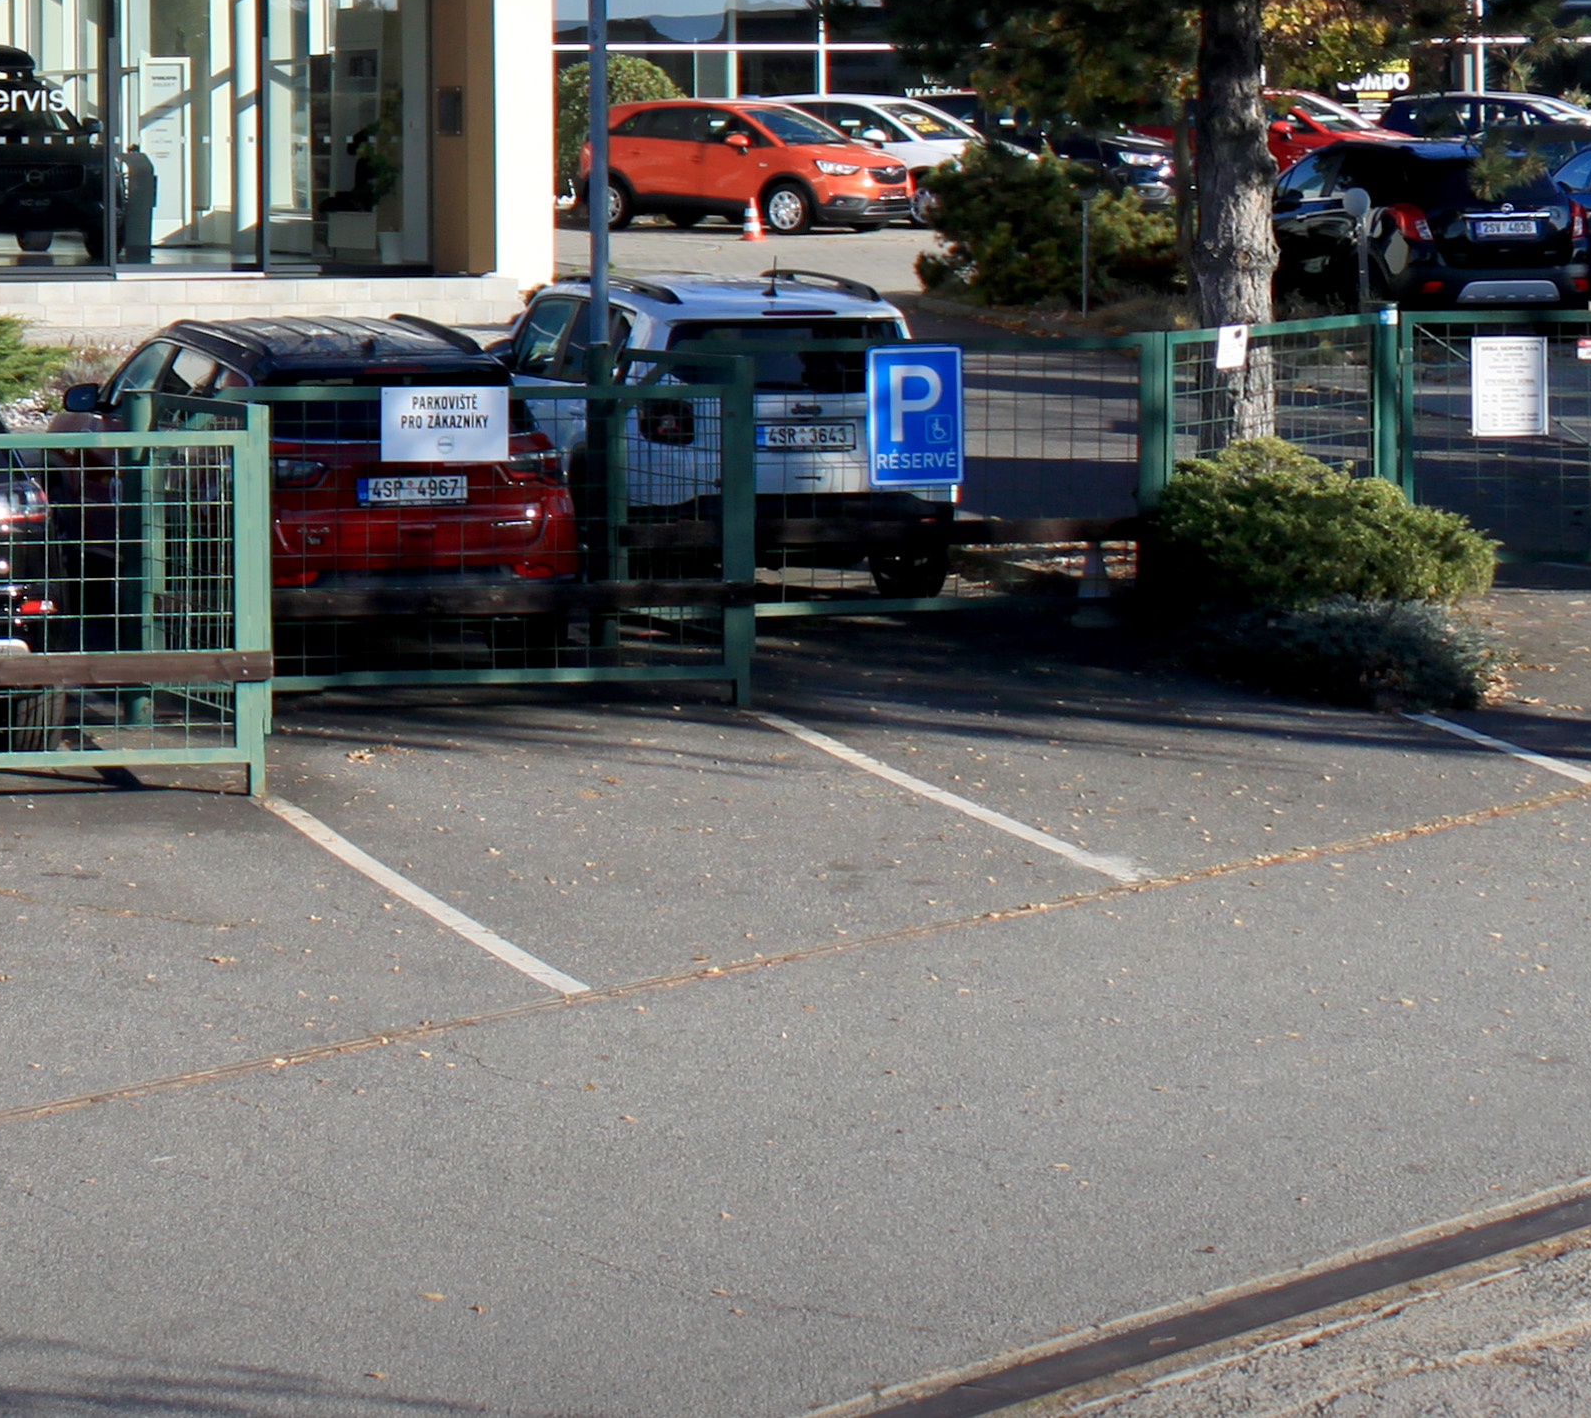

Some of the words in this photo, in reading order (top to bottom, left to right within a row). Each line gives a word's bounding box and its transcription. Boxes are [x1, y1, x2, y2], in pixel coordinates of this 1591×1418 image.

[412, 393, 479, 411] PARKOVIŠTĚ
[889, 364, 942, 443] P
[401, 414, 423, 429] PRO
[427, 412, 489, 429] ZÁKAZNÍKY
[769, 428, 797, 444] 4SR
[876, 447, 957, 470] RÉSERVÉ
[372, 480, 403, 498] 4SP
[417, 478, 459, 497] 4967
